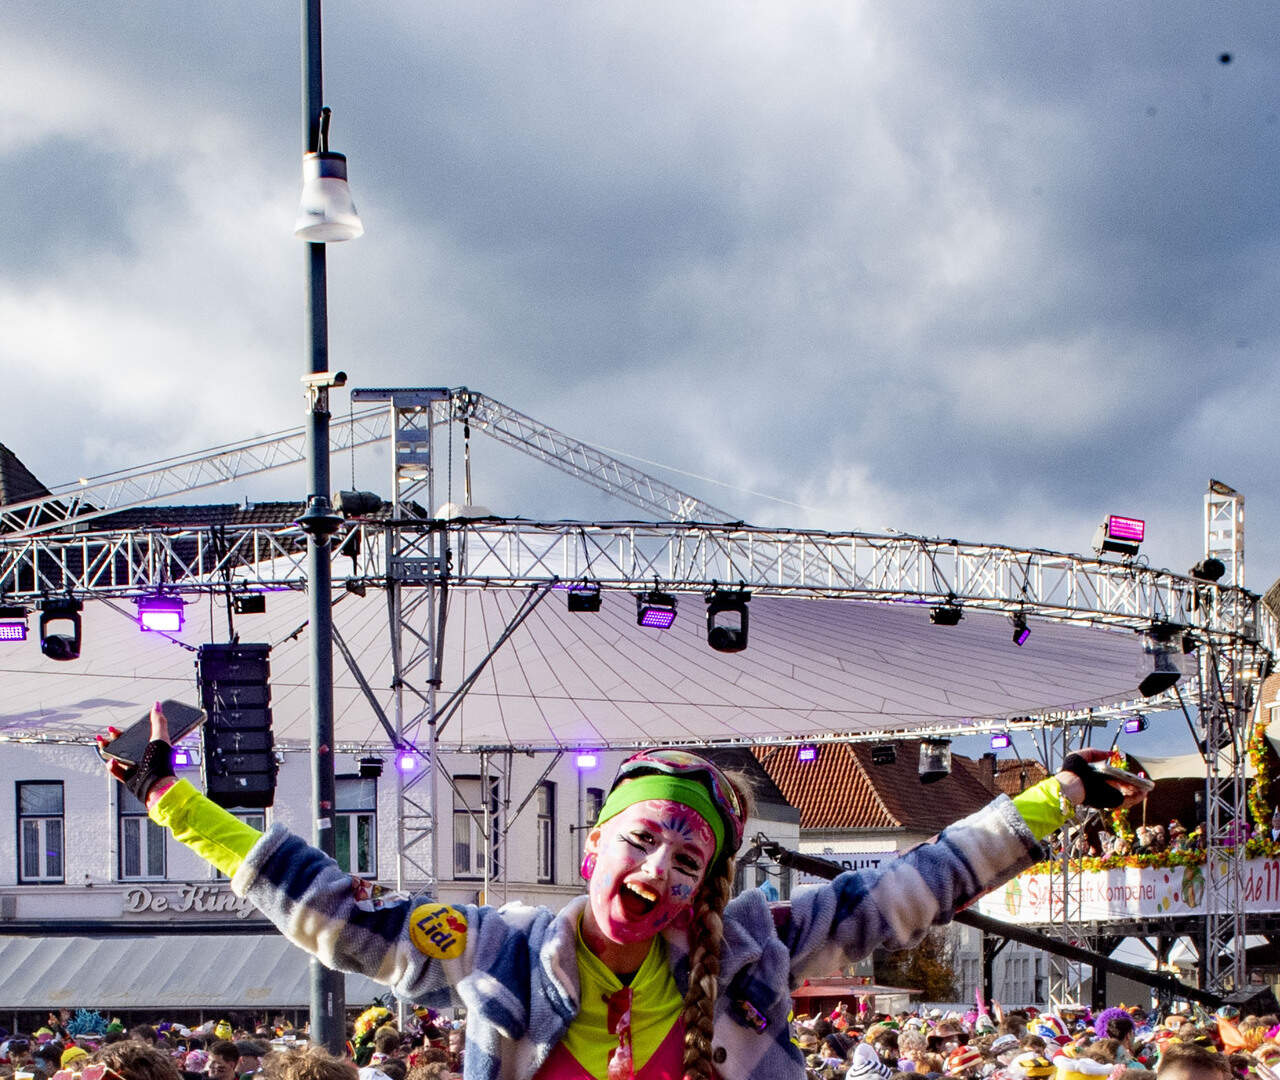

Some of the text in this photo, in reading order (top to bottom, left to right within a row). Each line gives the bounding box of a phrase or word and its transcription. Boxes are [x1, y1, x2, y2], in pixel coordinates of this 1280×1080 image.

[126, 886, 169, 913] De
[431, 907, 449, 919] I
[416, 915, 457, 952] Lidl
